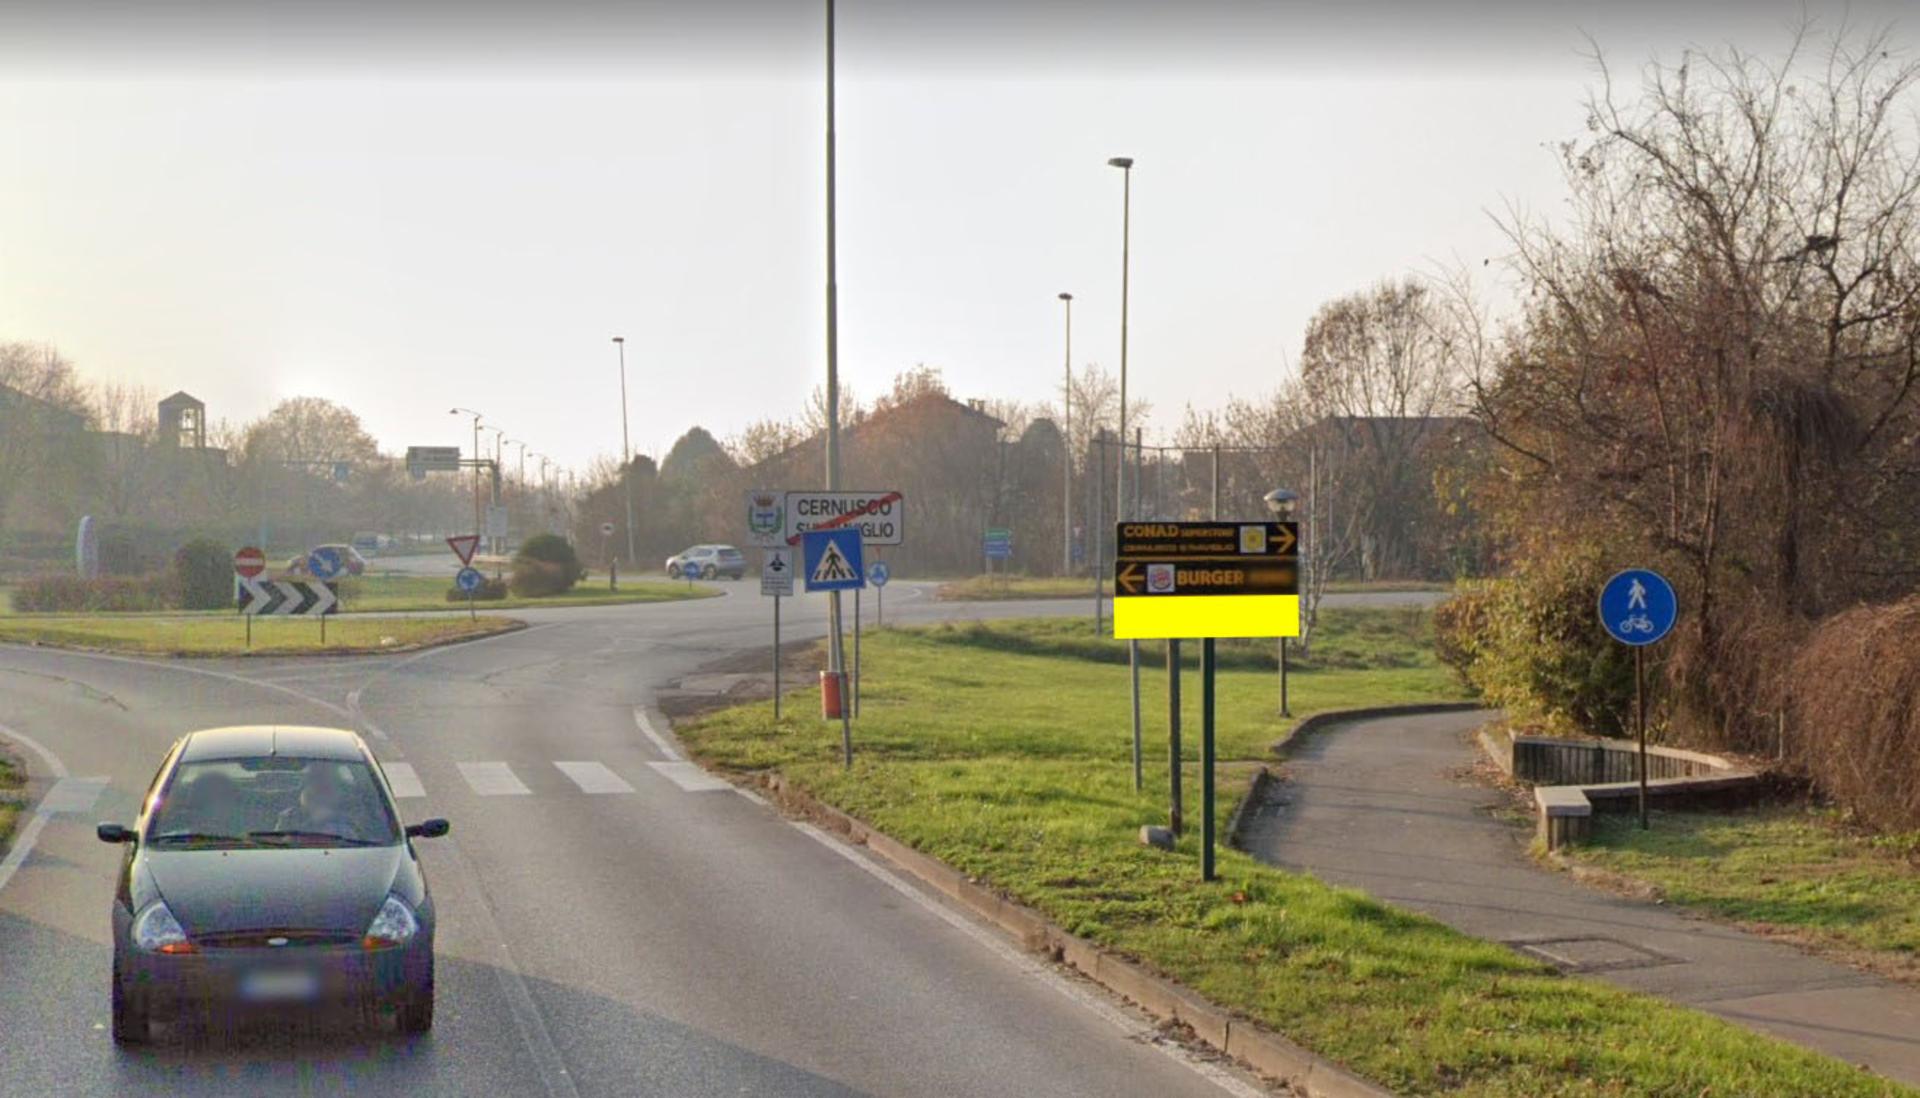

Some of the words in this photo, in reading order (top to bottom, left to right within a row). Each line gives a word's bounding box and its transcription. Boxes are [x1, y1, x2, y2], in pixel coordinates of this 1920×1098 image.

[797, 498, 893, 516] CERNUSCO
[1123, 524, 1179, 538] CONAD
[1176, 569, 1245, 586] BURGER
